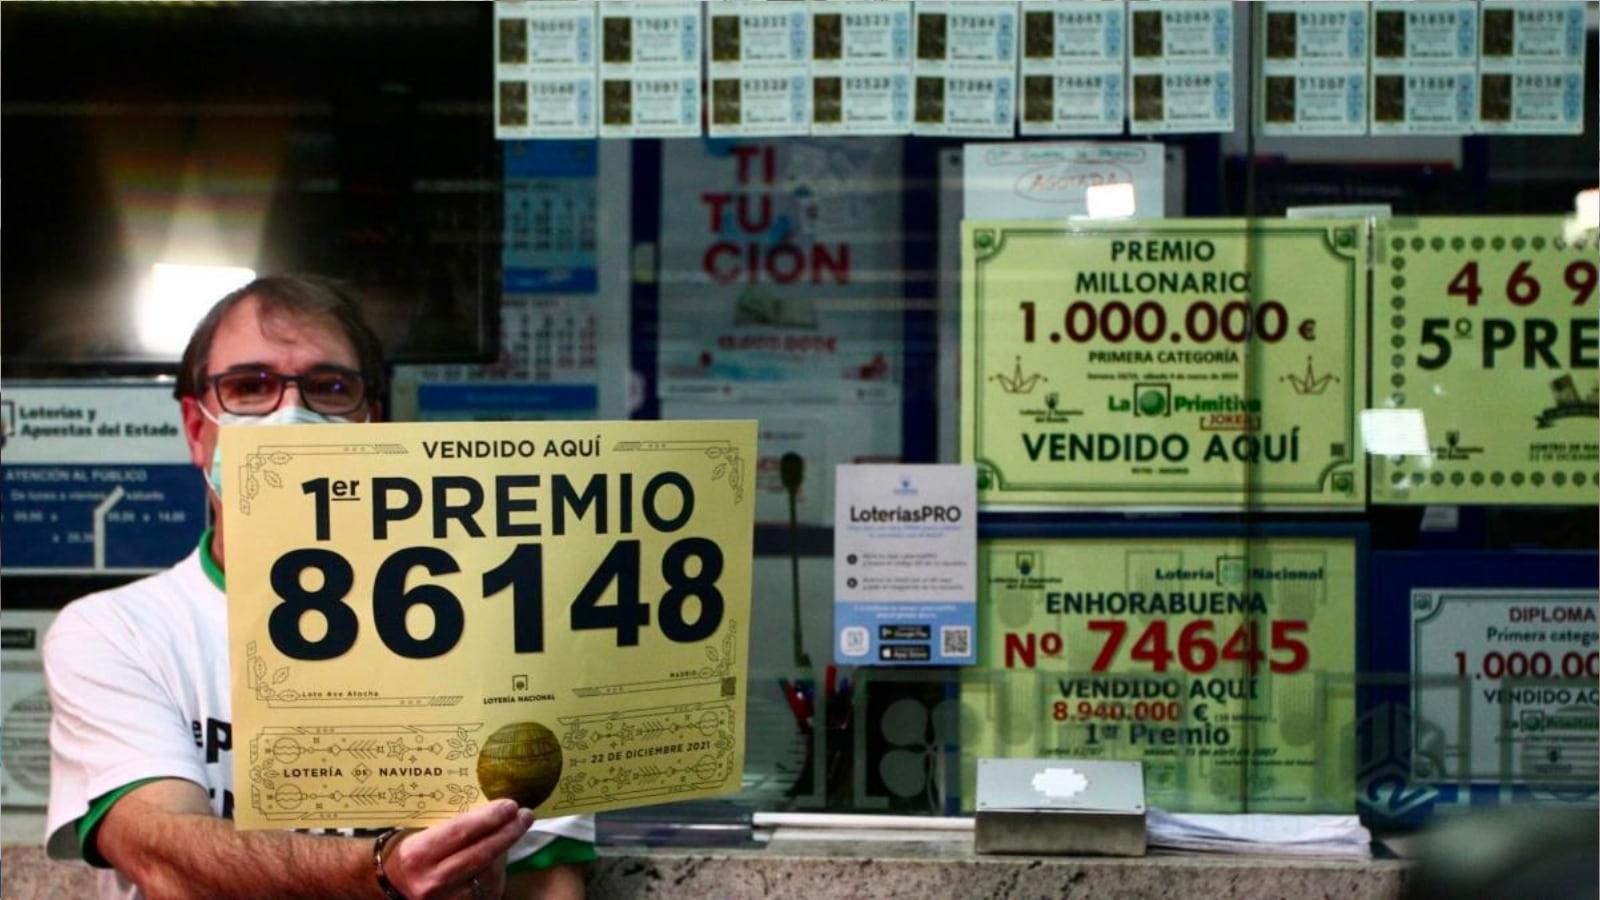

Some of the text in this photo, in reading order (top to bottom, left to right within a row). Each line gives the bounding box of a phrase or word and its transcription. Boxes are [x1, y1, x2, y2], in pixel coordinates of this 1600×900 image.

[734, 145, 775, 185] TI
[703, 194, 772, 233] TU
[704, 233, 851, 285] CIÓN
[1111, 241, 1215, 262] PREMIO
[1076, 272, 1251, 294] MILLONARIO
[1020, 301, 1316, 342] 1.000.000 €
[1089, 349, 1239, 364] PRIMERA CATEGORÍA
[1109, 394, 1260, 412] La Primitiva
[88, 408, 96, 423] y
[21, 422, 178, 439] Apuestas del Estado
[422, 435, 602, 459] VENDIDO AQUÍ
[1021, 427, 1299, 464] VENDIDO AQUÍ
[72, 470, 87, 482] AL
[371, 471, 695, 541] PREMIO
[1251, 566, 1323, 580] Nacional
[268, 537, 724, 661] 86148
[1046, 592, 1268, 615] ENHORABUENA
[1509, 606, 1596, 623] DIPLOMA
[1487, 626, 1546, 642] Primera
[1088, 620, 1310, 674] 74645
[302, 690, 323, 698] Loto
[483, 692, 556, 705] LOTERÍA NACIONAL
[1058, 679, 1181, 700] VENDIDO
[1484, 689, 1572, 704] VENDIDO
[1052, 701, 1182, 722] 8.940.000
[1193, 703, 1208, 723] €
[1130, 721, 1231, 745] Premio
[591, 740, 711, 765] 22 DE DICIEMBRE 2021
[283, 765, 443, 778] LOTERÍA DE NAVIDAD
